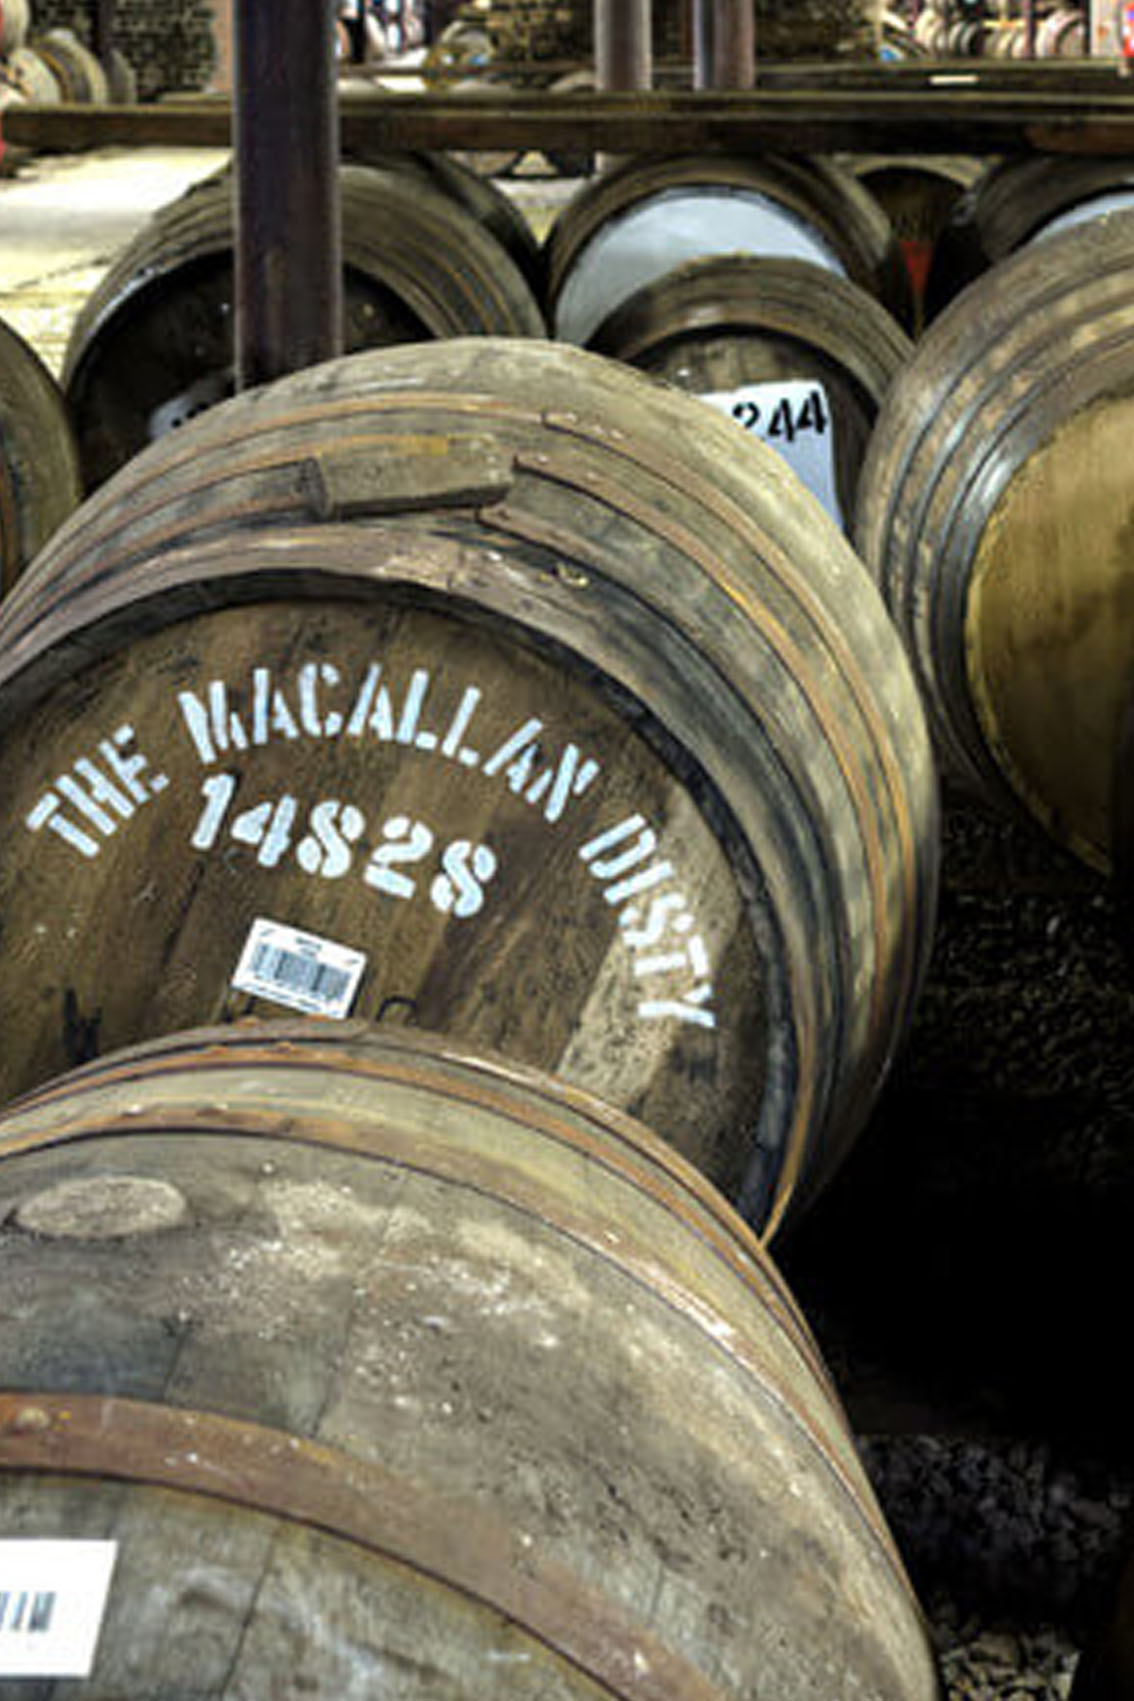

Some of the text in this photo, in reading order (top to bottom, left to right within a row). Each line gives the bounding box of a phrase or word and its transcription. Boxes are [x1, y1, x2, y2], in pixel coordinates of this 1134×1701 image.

[25, 662, 716, 1028] THE MACALLAN DISTY
[191, 773, 497, 917] 14828
